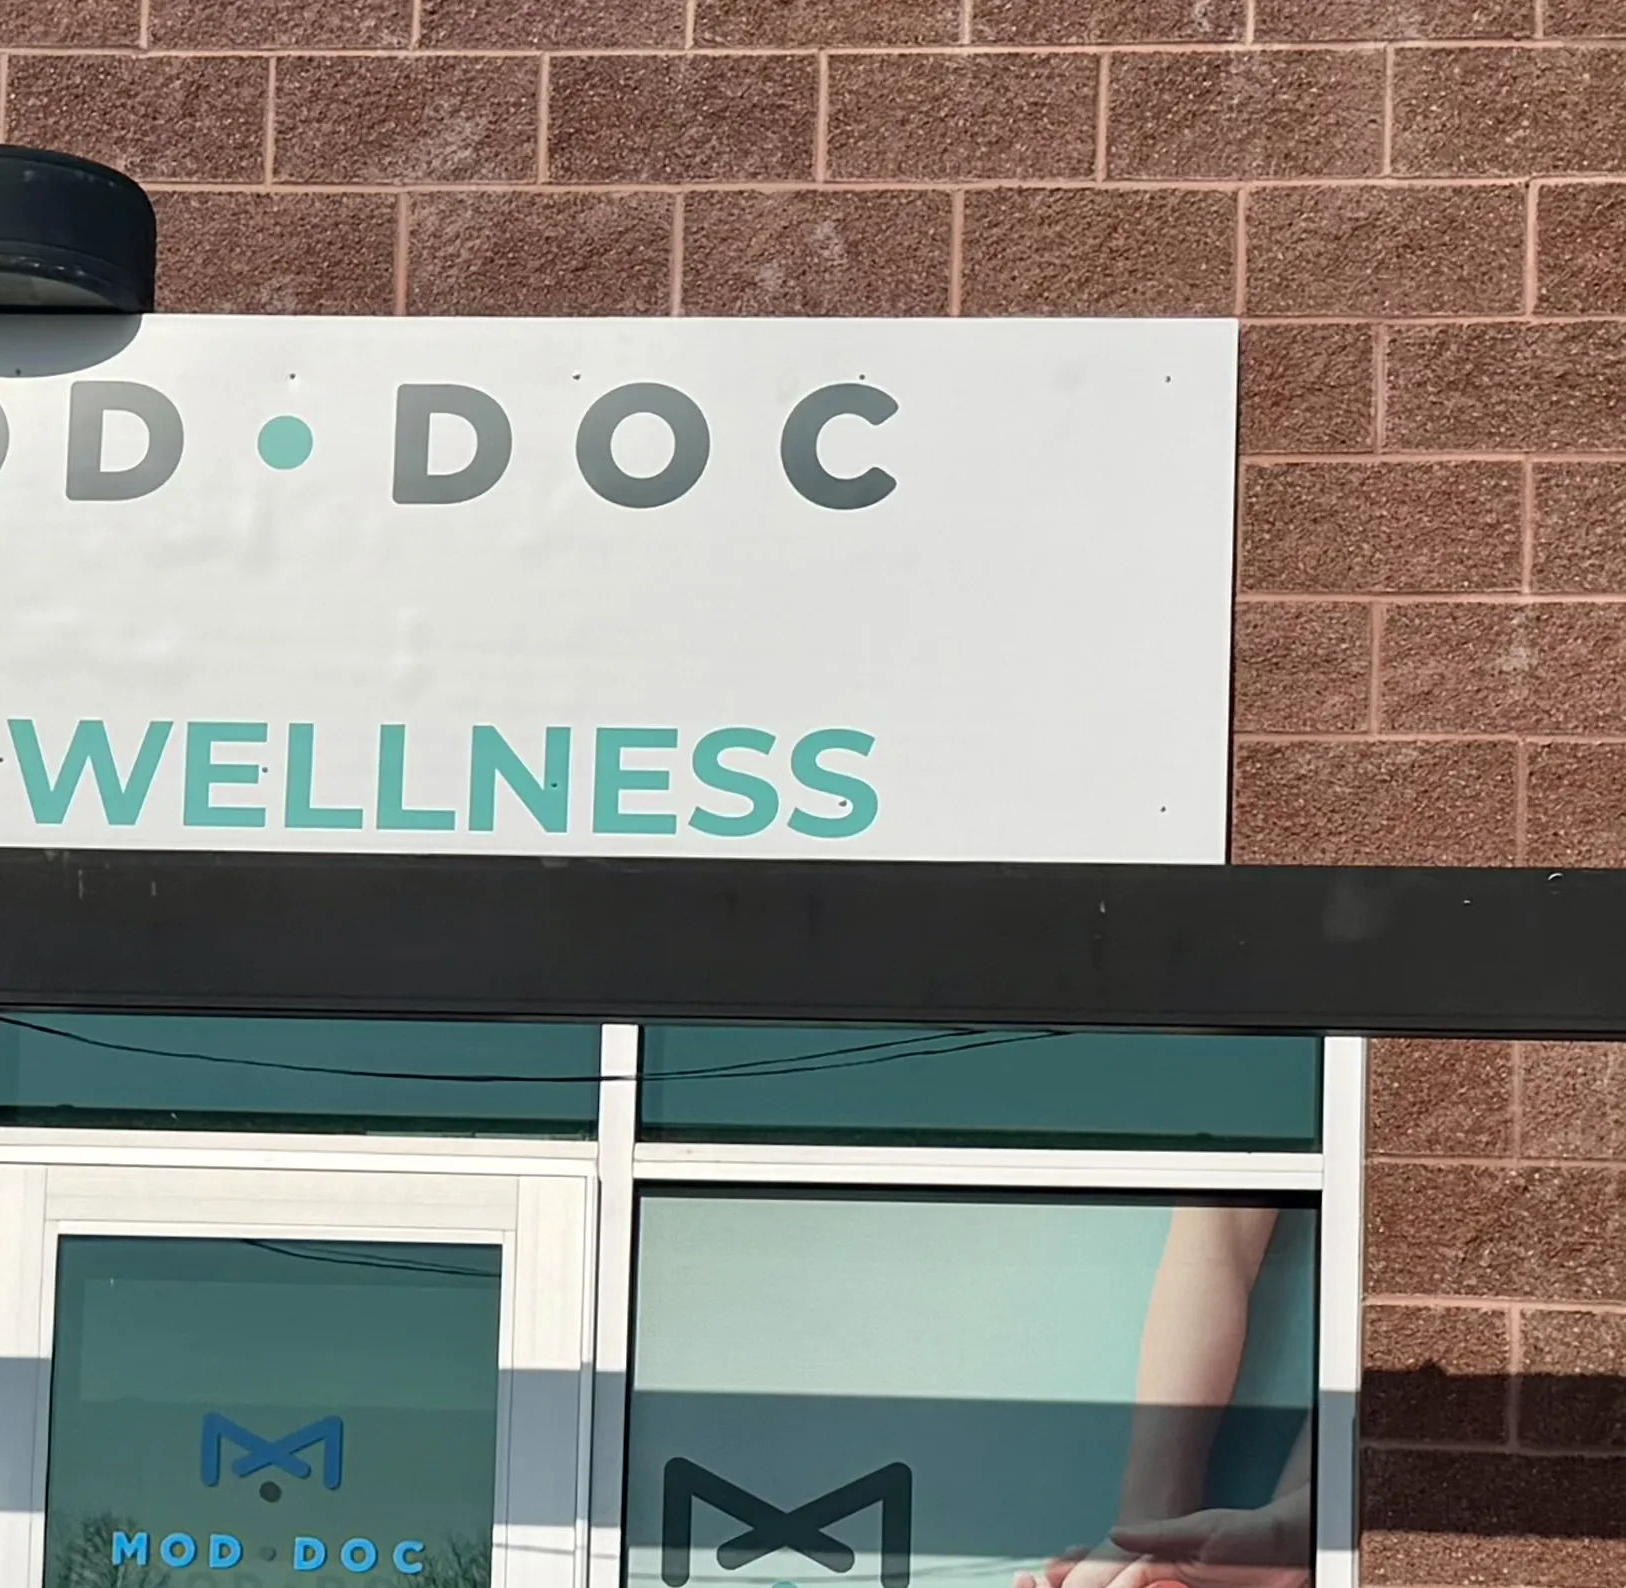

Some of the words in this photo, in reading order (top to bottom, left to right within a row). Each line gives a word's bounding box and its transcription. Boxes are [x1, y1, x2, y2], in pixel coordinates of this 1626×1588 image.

[391, 382, 899, 511] DOC
[7, 718, 880, 839] WELLNESS
[112, 1531, 243, 1570] MOD
[293, 1536, 425, 1575] DOC
